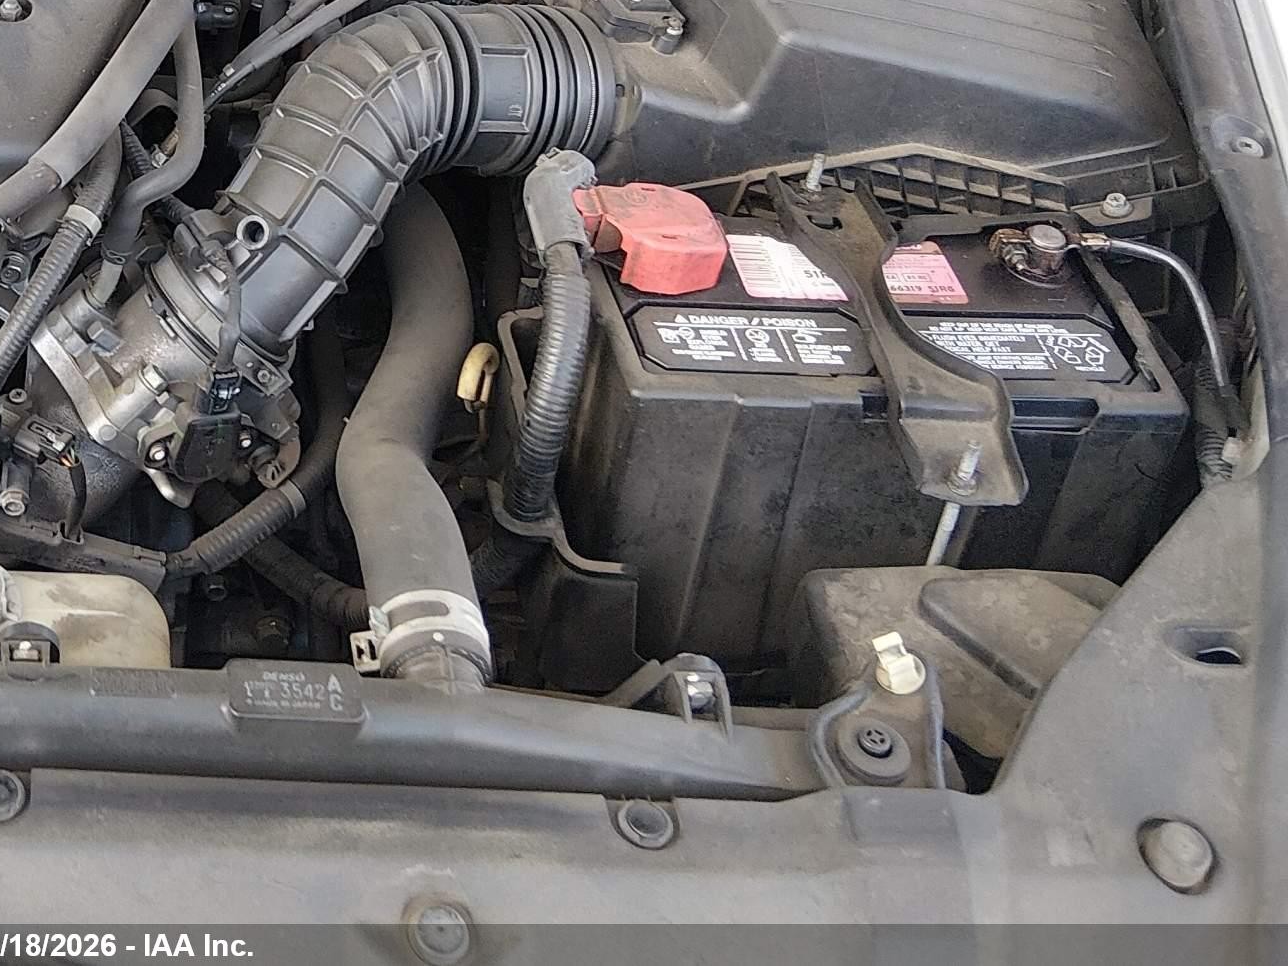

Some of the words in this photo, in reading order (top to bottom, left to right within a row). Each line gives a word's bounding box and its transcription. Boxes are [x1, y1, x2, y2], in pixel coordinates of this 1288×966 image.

[688, 315, 749, 326] DANGER
[762, 317, 817, 328] POISON
[263, 671, 306, 682] DENSO
[328, 674, 343, 694] A
[280, 681, 327, 701] 3542
